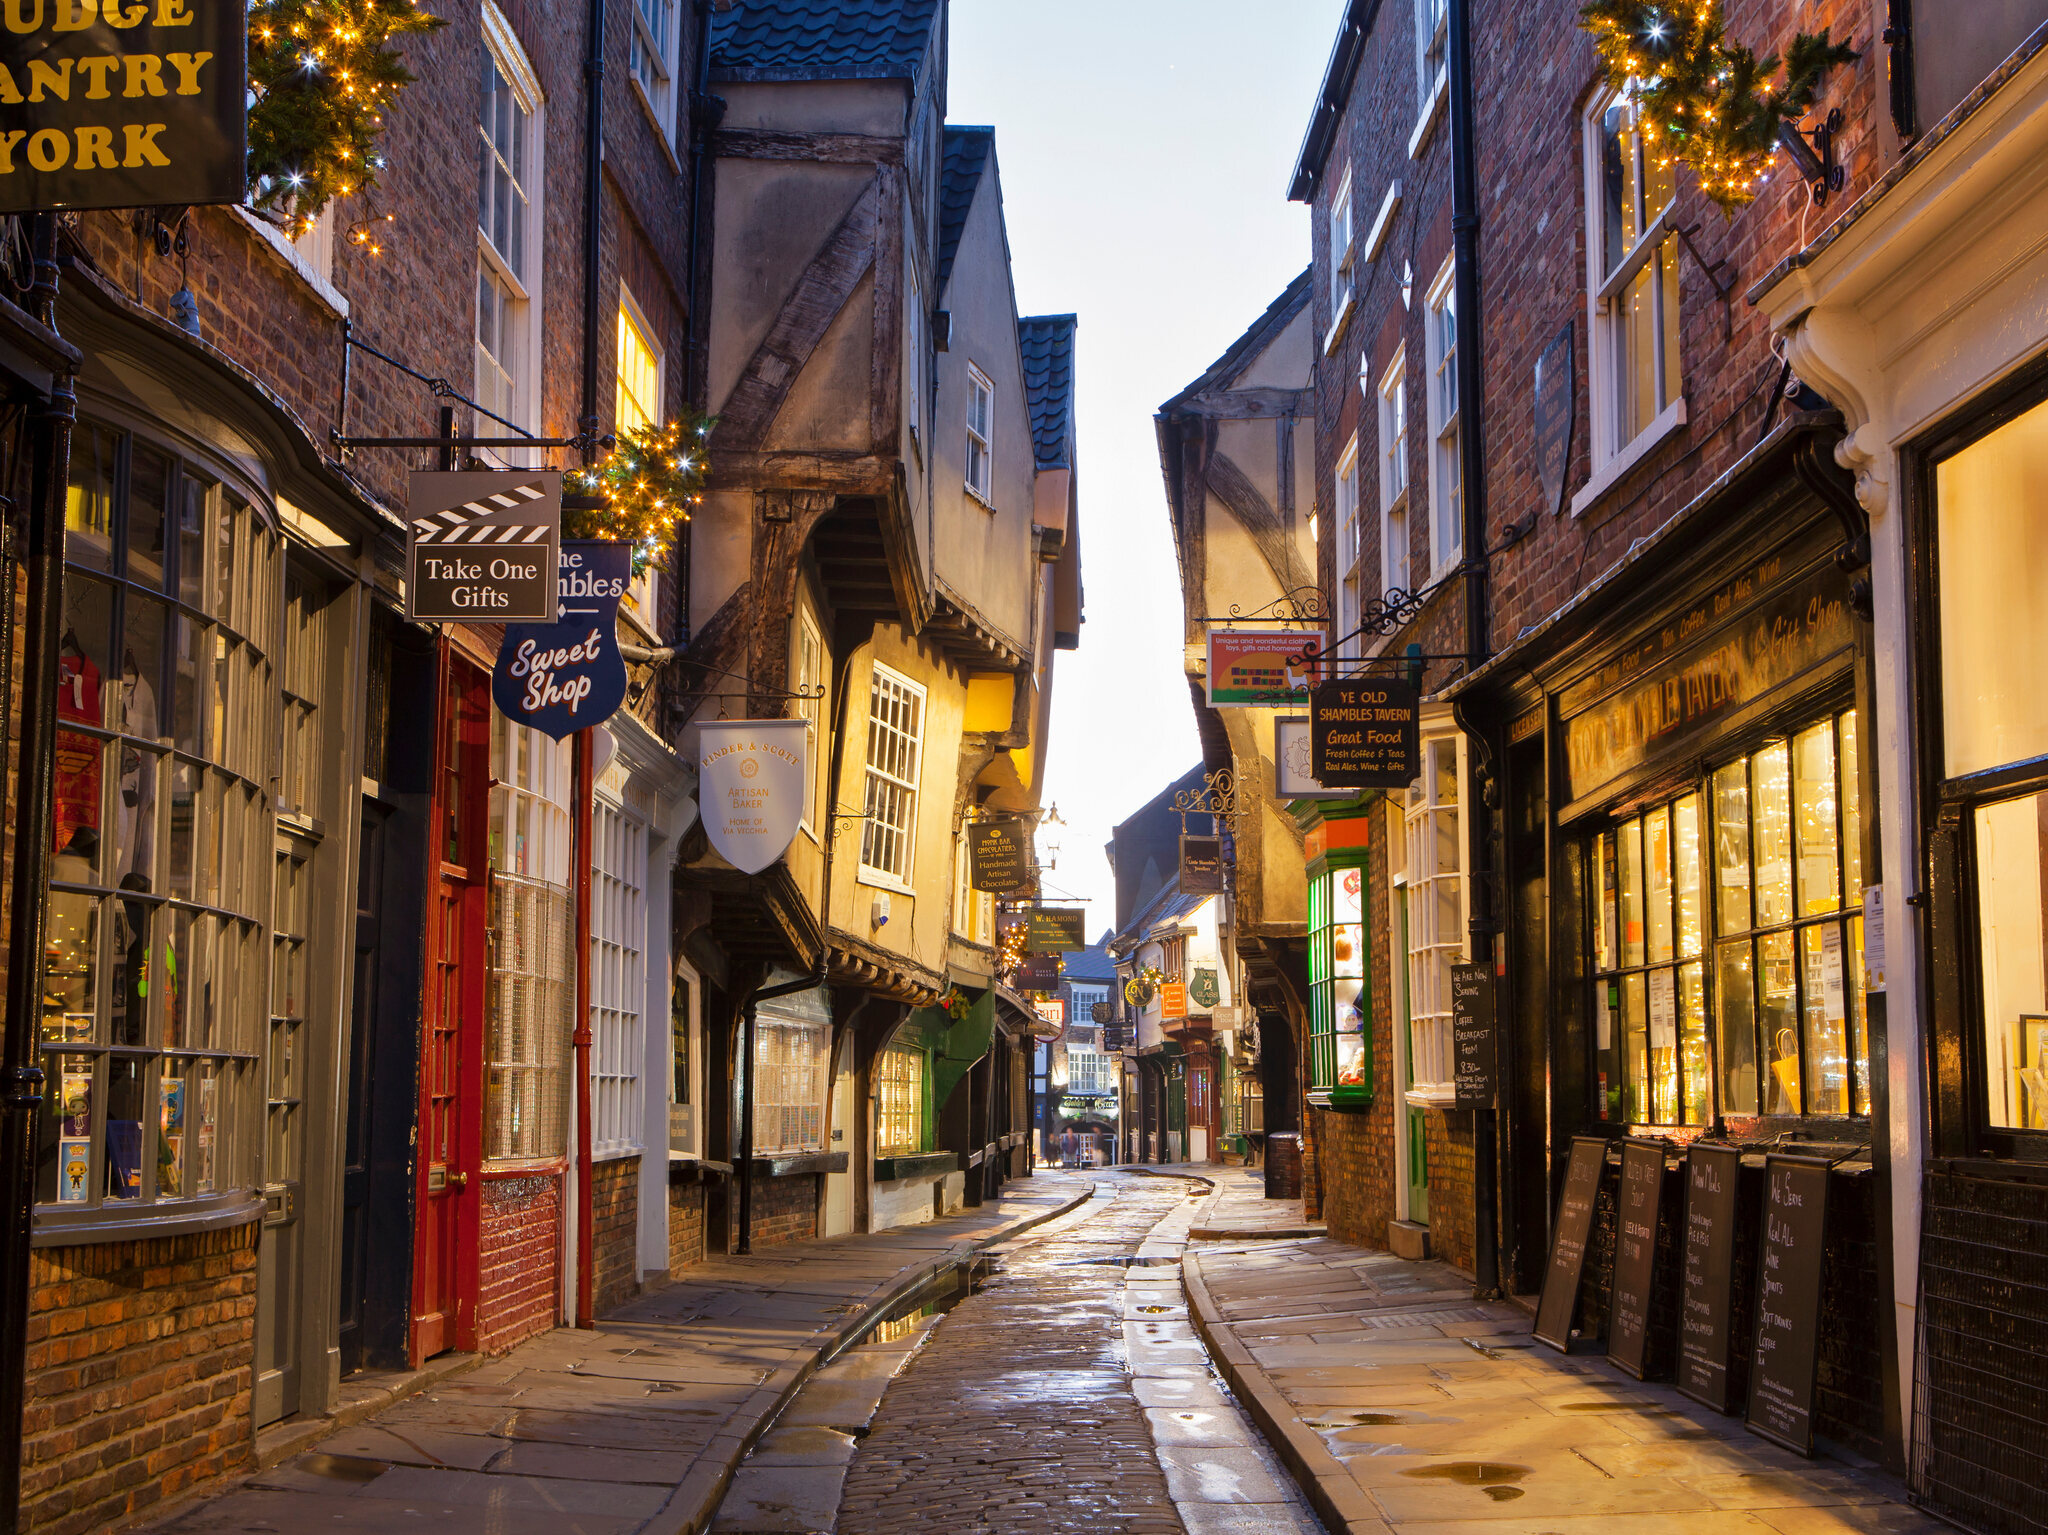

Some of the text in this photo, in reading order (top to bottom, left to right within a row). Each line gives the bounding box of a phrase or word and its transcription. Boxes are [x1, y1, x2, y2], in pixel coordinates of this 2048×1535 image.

[425, 559, 537, 580] Take One
[1758, 557, 1781, 585] Wine
[451, 587, 509, 608] Gifts
[1806, 595, 1841, 647] Shop
[509, 627, 602, 678] Sweet
[1243, 645, 1256, 653] gifts
[521, 671, 592, 713] Shop
[1341, 692, 1387, 703] YE OLD
[1320, 708, 1411, 721] SHAMBLES TAVERN
[1327, 729, 1402, 745] Great Food
[701, 742, 800, 768] PINDER & SCOTT
[1326, 749, 1349, 758] Fresh
[1351, 749, 1375, 758] Coffee
[1387, 749, 1406, 758] Teas
[1325, 762, 1405, 771] Real Ales, Wine Gifts
[728, 787, 769, 797] ARTISAN
[732, 799, 763, 809] BAKER
[729, 818, 763, 826] HOME OF
[722, 827, 735, 835] VIA
[979, 859, 1018, 869] Handmade
[980, 879, 1019, 889] Chocolates
[1035, 914, 1045, 922] W.
[1453, 971, 1461, 982] WE
[1462, 971, 1473, 981] ARE
[1455, 983, 1479, 997] SERVING
[1453, 1000, 1465, 1011] TEA
[1454, 1012, 1474, 1026] COFFEE
[1455, 1029, 1490, 1042] BREAKFAST
[1461, 1043, 1478, 1055] FROM
[1771, 1171, 1803, 1207] WE SERVE
[1781, 1223, 1795, 1247] ALE
[1765, 1246, 1780, 1270] WINE
[1774, 1314, 1793, 1331] DRINKS
[1758, 1328, 1777, 1350] COFFEE
[1756, 1349, 1765, 1366] TEA
